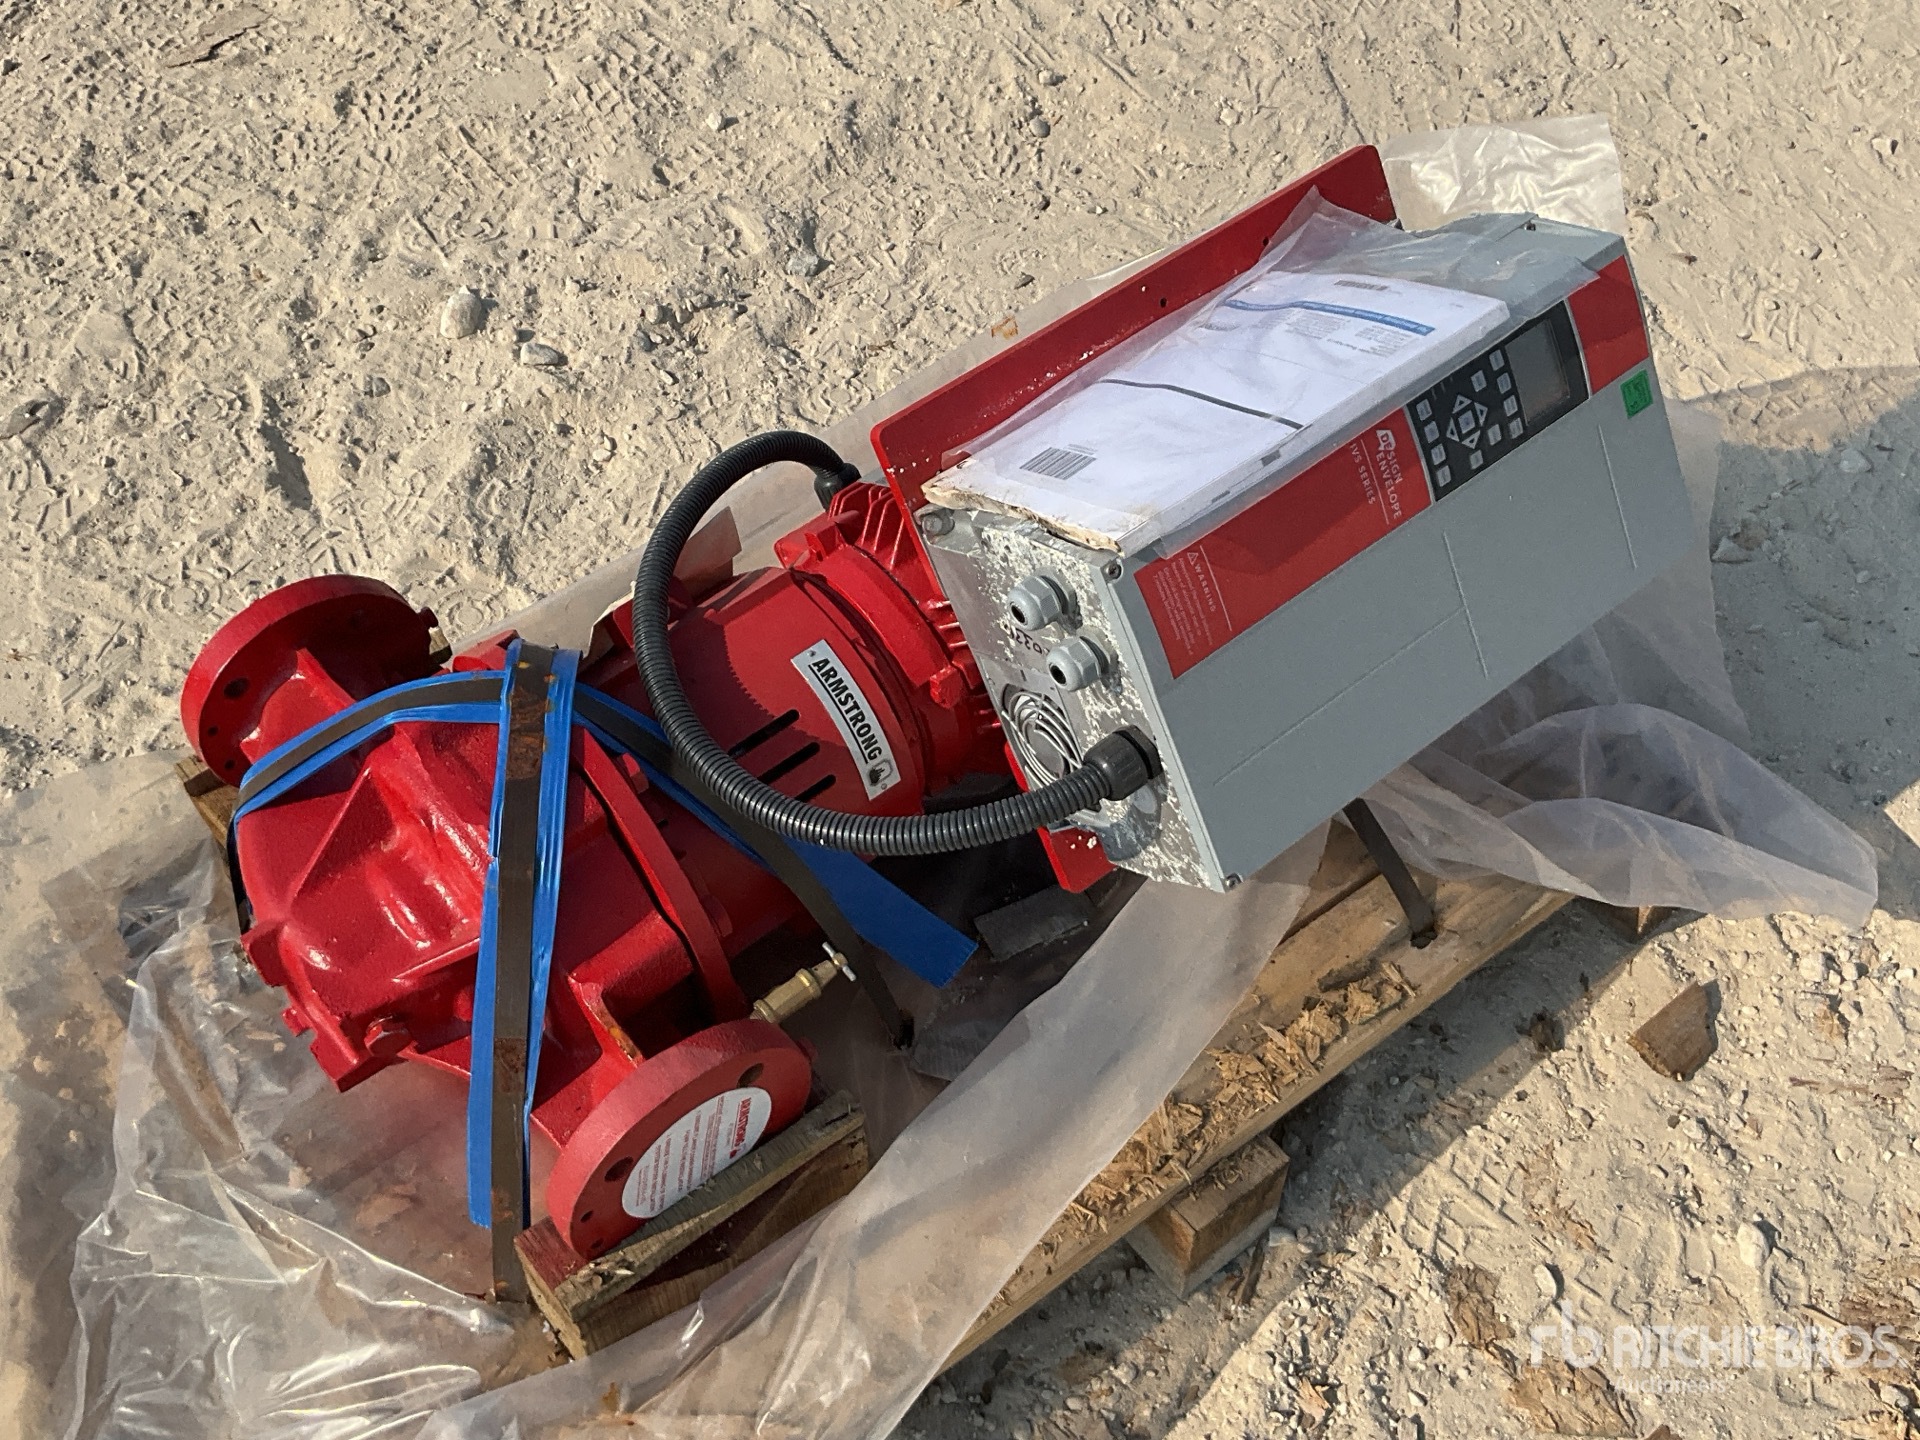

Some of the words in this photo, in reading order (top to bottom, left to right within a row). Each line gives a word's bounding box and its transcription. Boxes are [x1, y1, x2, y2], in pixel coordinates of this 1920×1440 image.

[1350, 443, 1362, 463] IVS
[1358, 465, 1376, 505] SERIES
[1376, 450, 1402, 519] ENVELOPE
[1379, 431, 1403, 484] DESIGN
[1195, 563, 1216, 612] WARNING
[812, 658, 883, 761] ARMSTRONG
